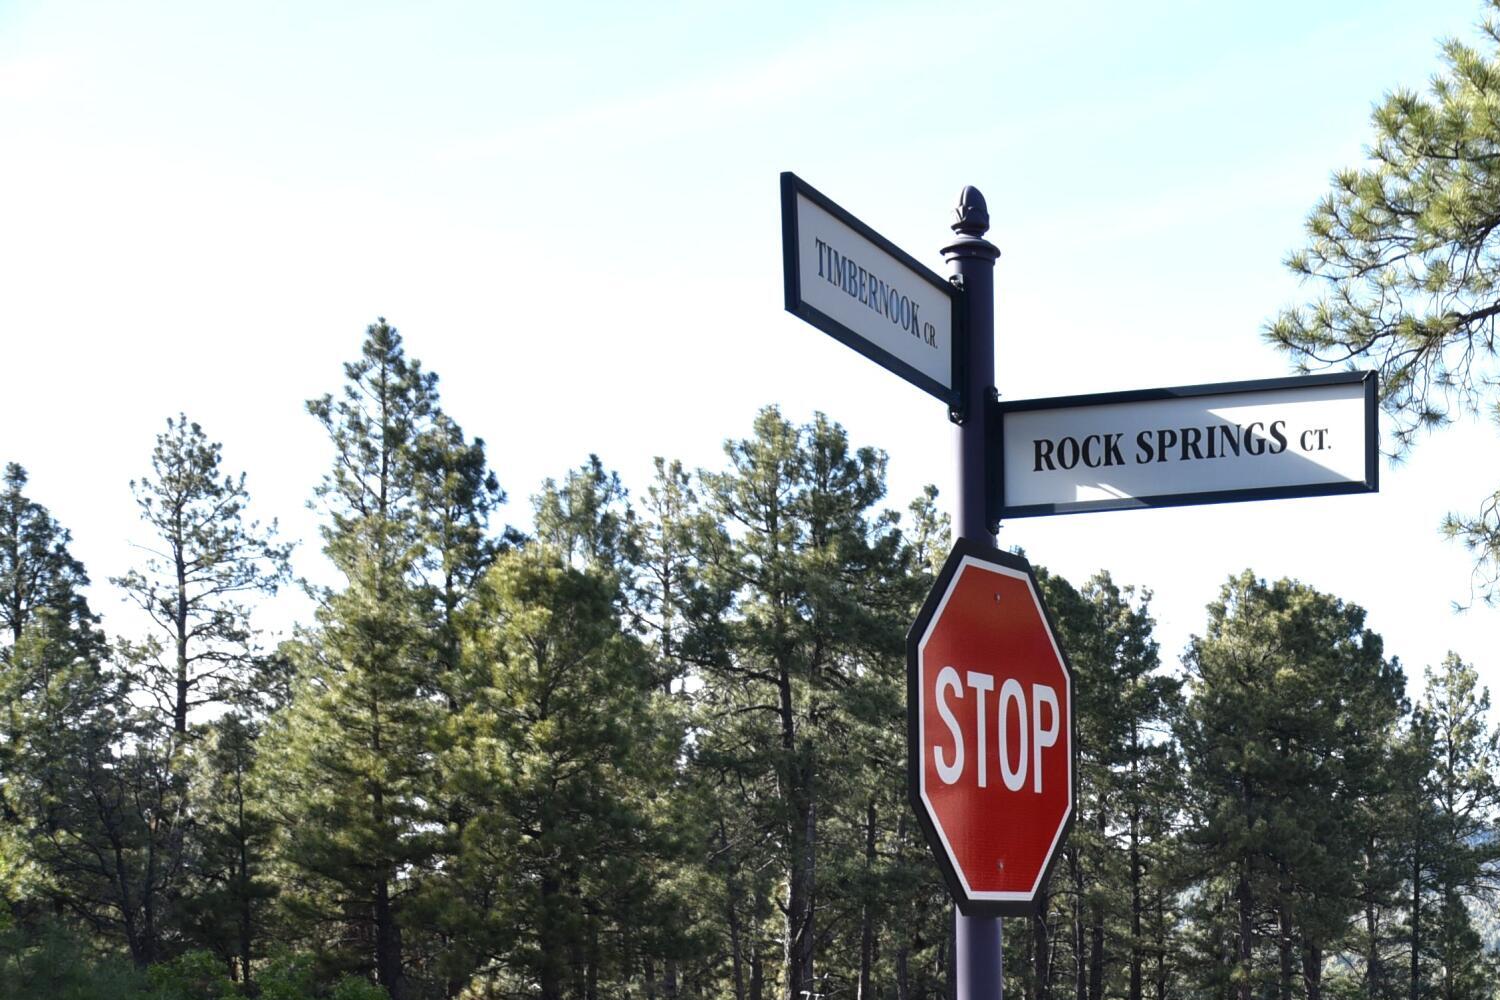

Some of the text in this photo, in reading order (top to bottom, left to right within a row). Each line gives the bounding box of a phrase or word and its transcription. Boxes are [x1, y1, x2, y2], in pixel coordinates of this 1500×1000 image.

[815, 236, 938, 349] TIMBERNOOK CR.
[1032, 420, 1332, 472] ROCK SPRINGS CT.
[933, 665, 1060, 794] STOP
